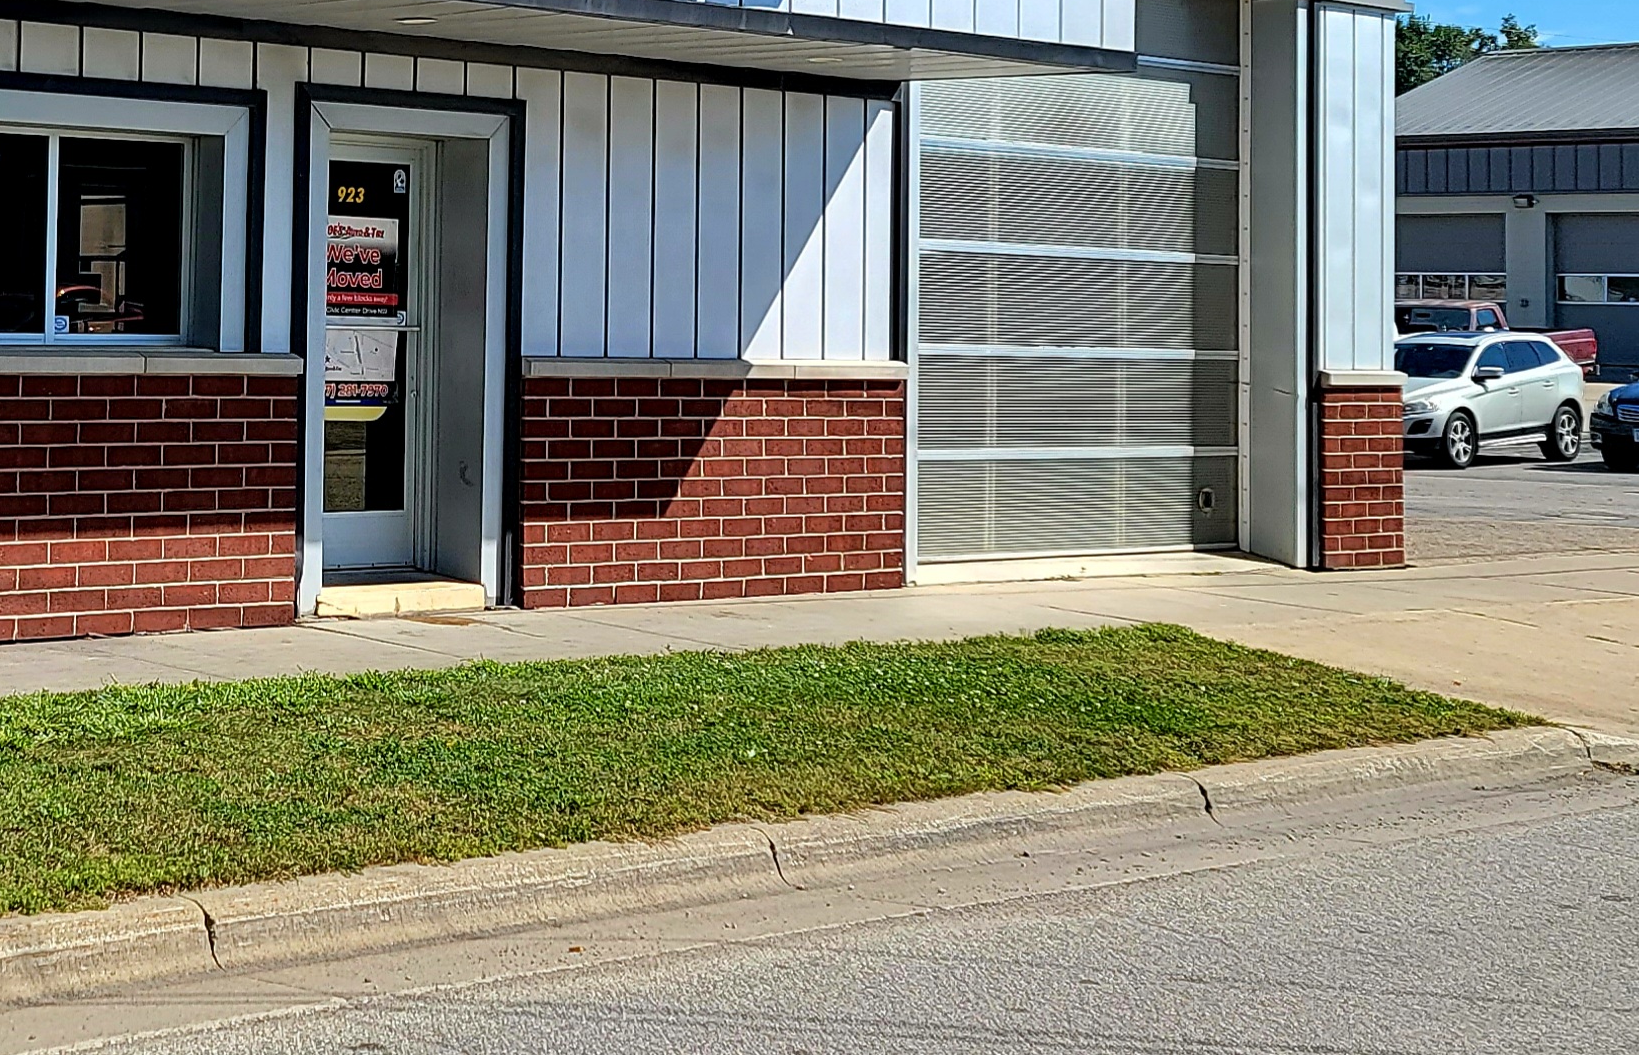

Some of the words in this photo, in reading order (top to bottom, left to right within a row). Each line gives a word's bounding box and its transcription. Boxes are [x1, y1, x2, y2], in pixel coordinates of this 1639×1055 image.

[337, 186, 365, 203] 923
[327, 222, 344, 236] OE'S
[327, 243, 381, 265] We've
[327, 294, 337, 303] nly
[340, 306, 362, 314] Center
